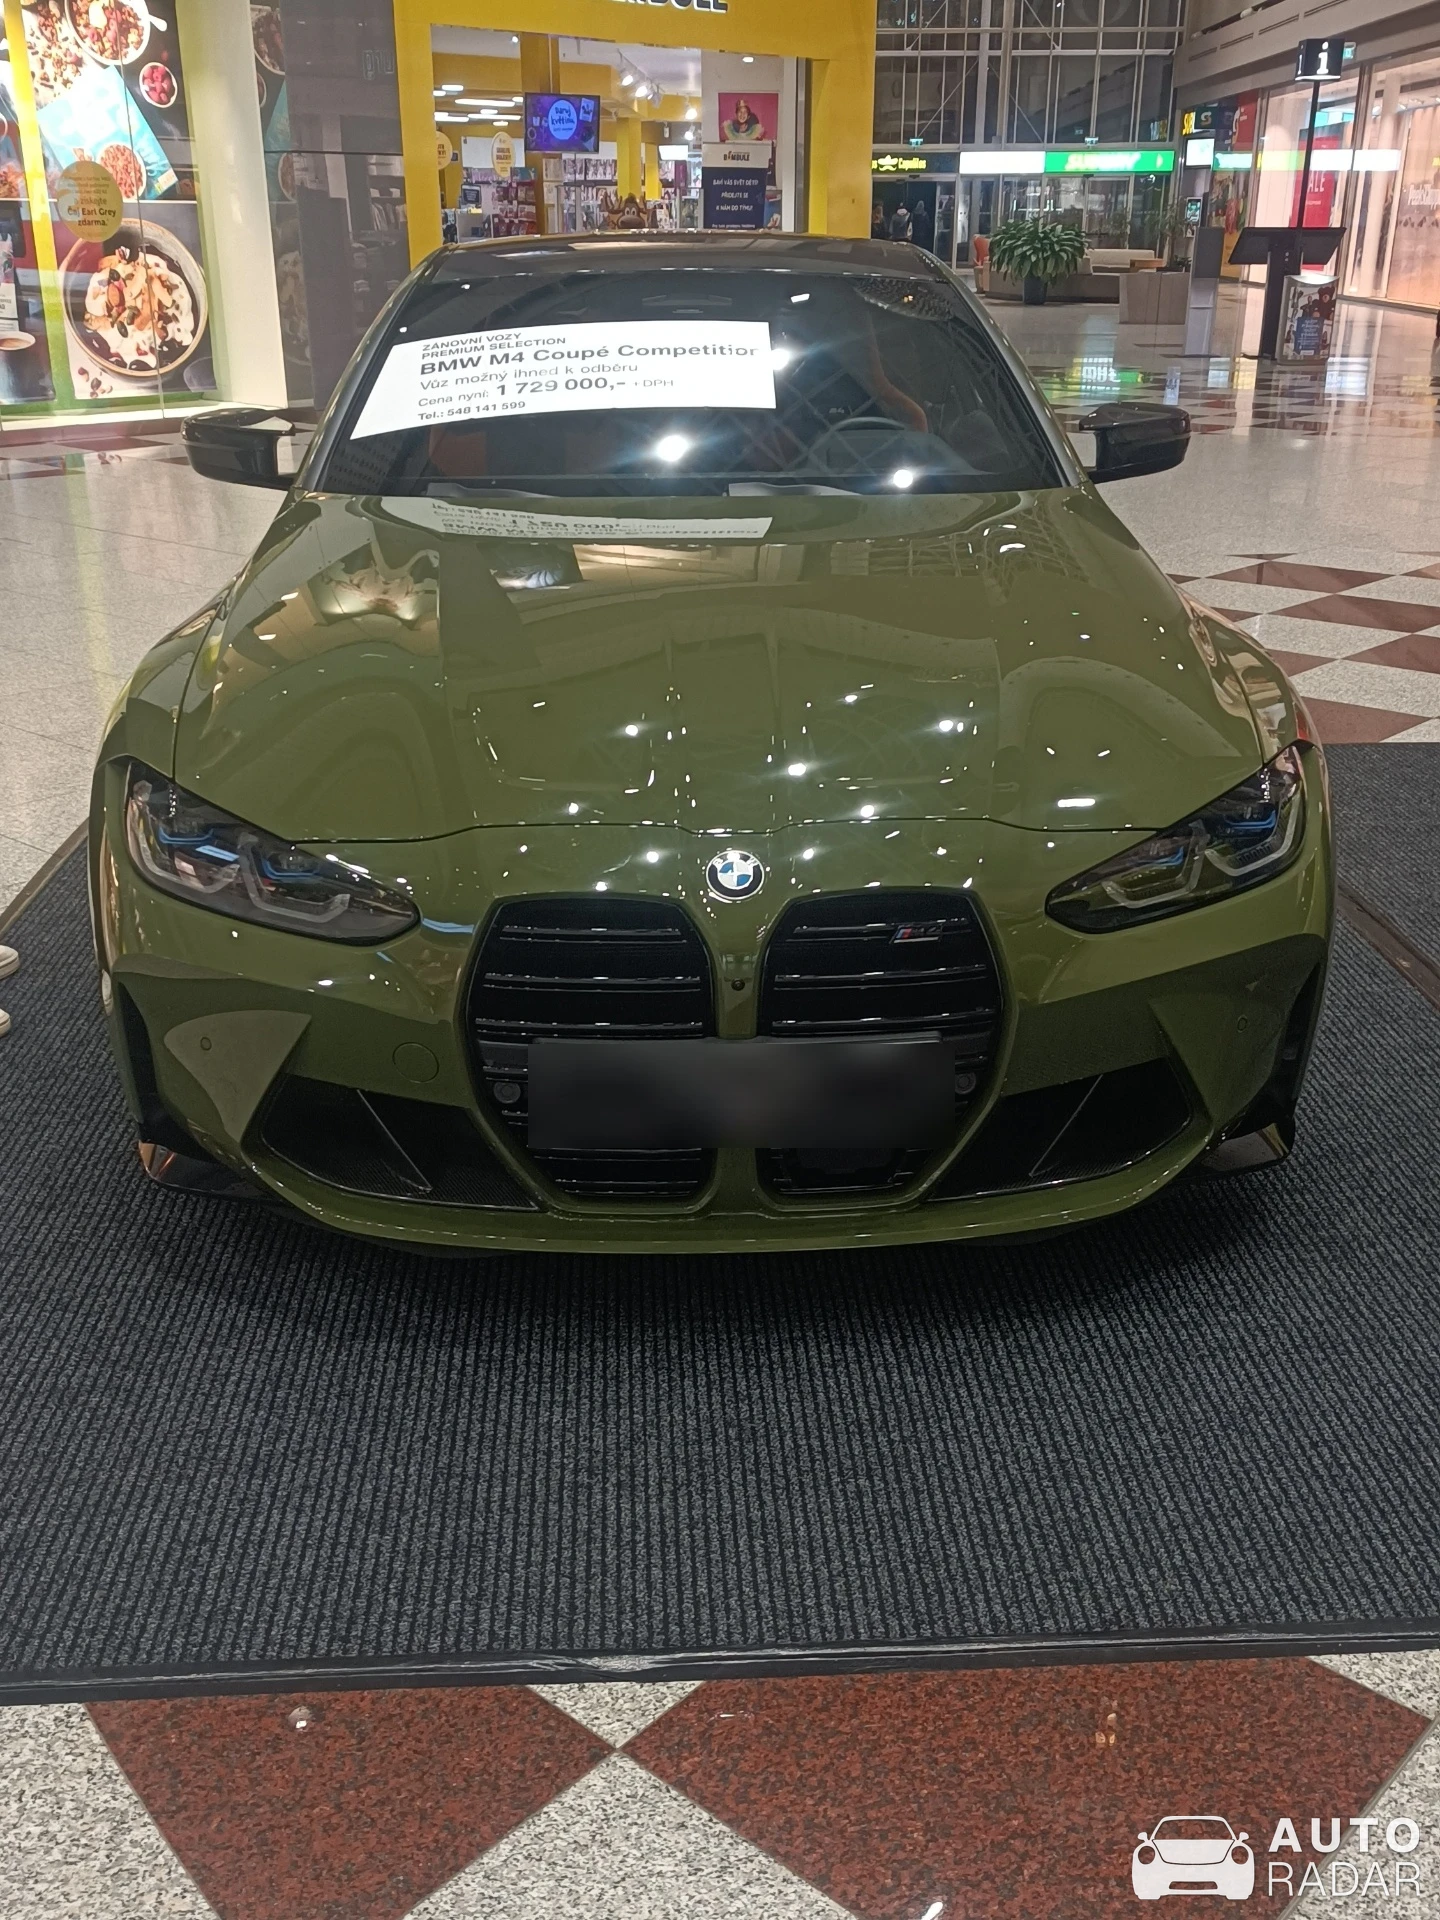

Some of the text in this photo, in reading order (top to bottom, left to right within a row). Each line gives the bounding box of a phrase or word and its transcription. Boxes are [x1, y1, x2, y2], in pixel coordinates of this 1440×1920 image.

[1307, 171, 1325, 193] ALE
[81, 207, 97, 216] Earl
[98, 207, 117, 218] Grey
[422, 337, 566, 360] PREMIUM SELECTION
[486, 333, 522, 342] VOZY
[420, 356, 482, 375] BMW
[489, 351, 525, 366] M4
[533, 346, 609, 361] Coupé
[420, 363, 638, 390] Vůz možný ihned k odběru
[418, 396, 453, 407] Cena
[458, 390, 489, 401] nyní:
[496, 384, 506, 396] 1
[515, 380, 558, 394] 729
[418, 401, 526, 420] Tel.: 548 141 599
